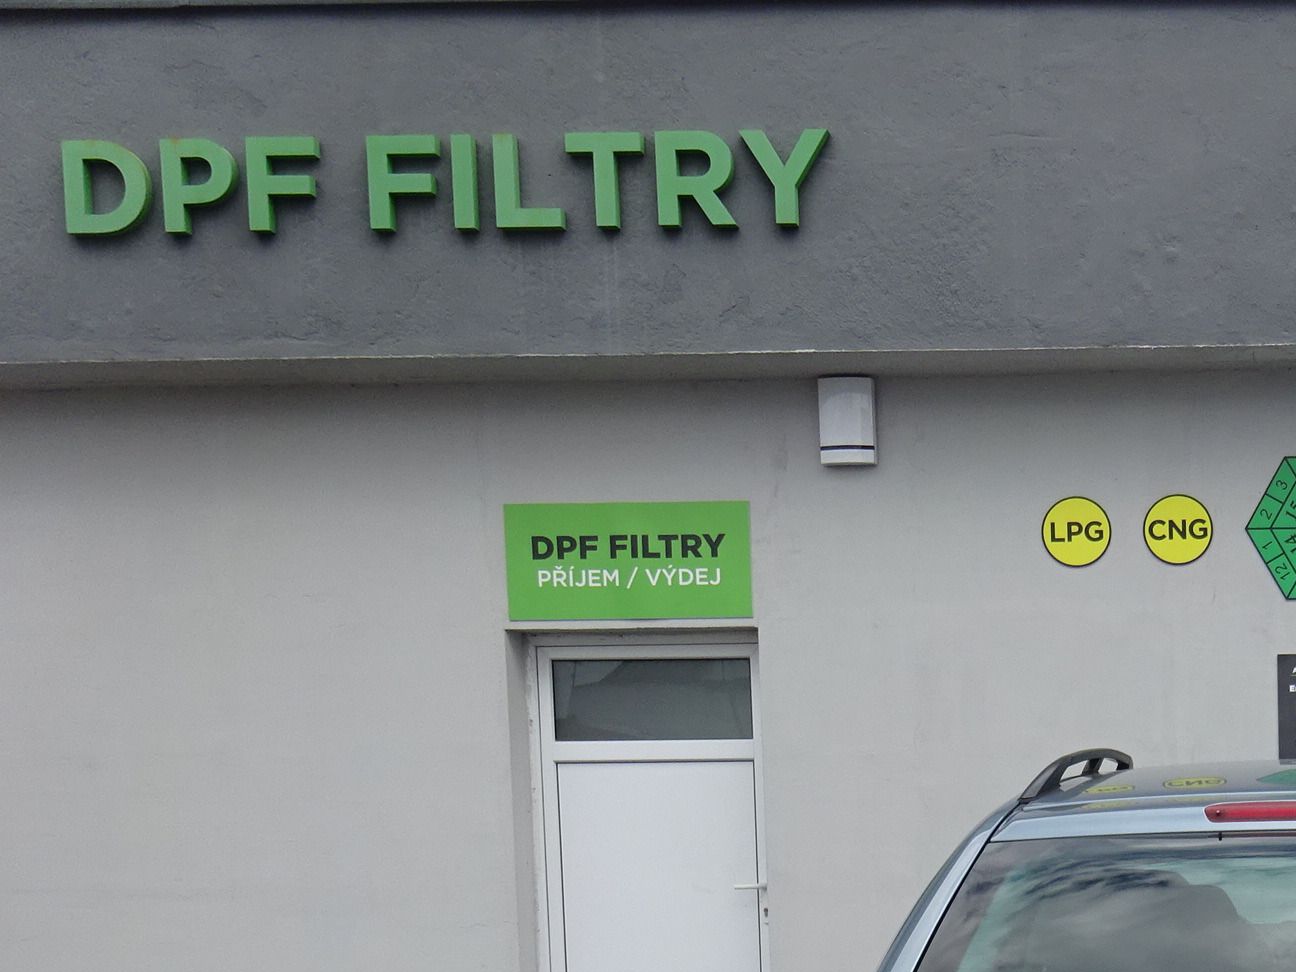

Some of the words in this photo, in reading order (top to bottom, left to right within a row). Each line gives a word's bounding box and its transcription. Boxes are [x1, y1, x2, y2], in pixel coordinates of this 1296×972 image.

[60, 135, 321, 236] DPF
[364, 128, 830, 233] FILTRY
[1275, 479, 1288, 491] 3
[1259, 508, 1273, 521] 2
[1049, 520, 1105, 544] LPG
[1147, 518, 1209, 541] CNG
[530, 535, 599, 561] DPF
[609, 533, 726, 560] FILTRY
[1261, 540, 1273, 551] 1
[537, 565, 620, 588] PŘÍJEM
[626, 566, 639, 590] /
[644, 564, 722, 587] VÝDEJ
[1274, 562, 1291, 581] 12
